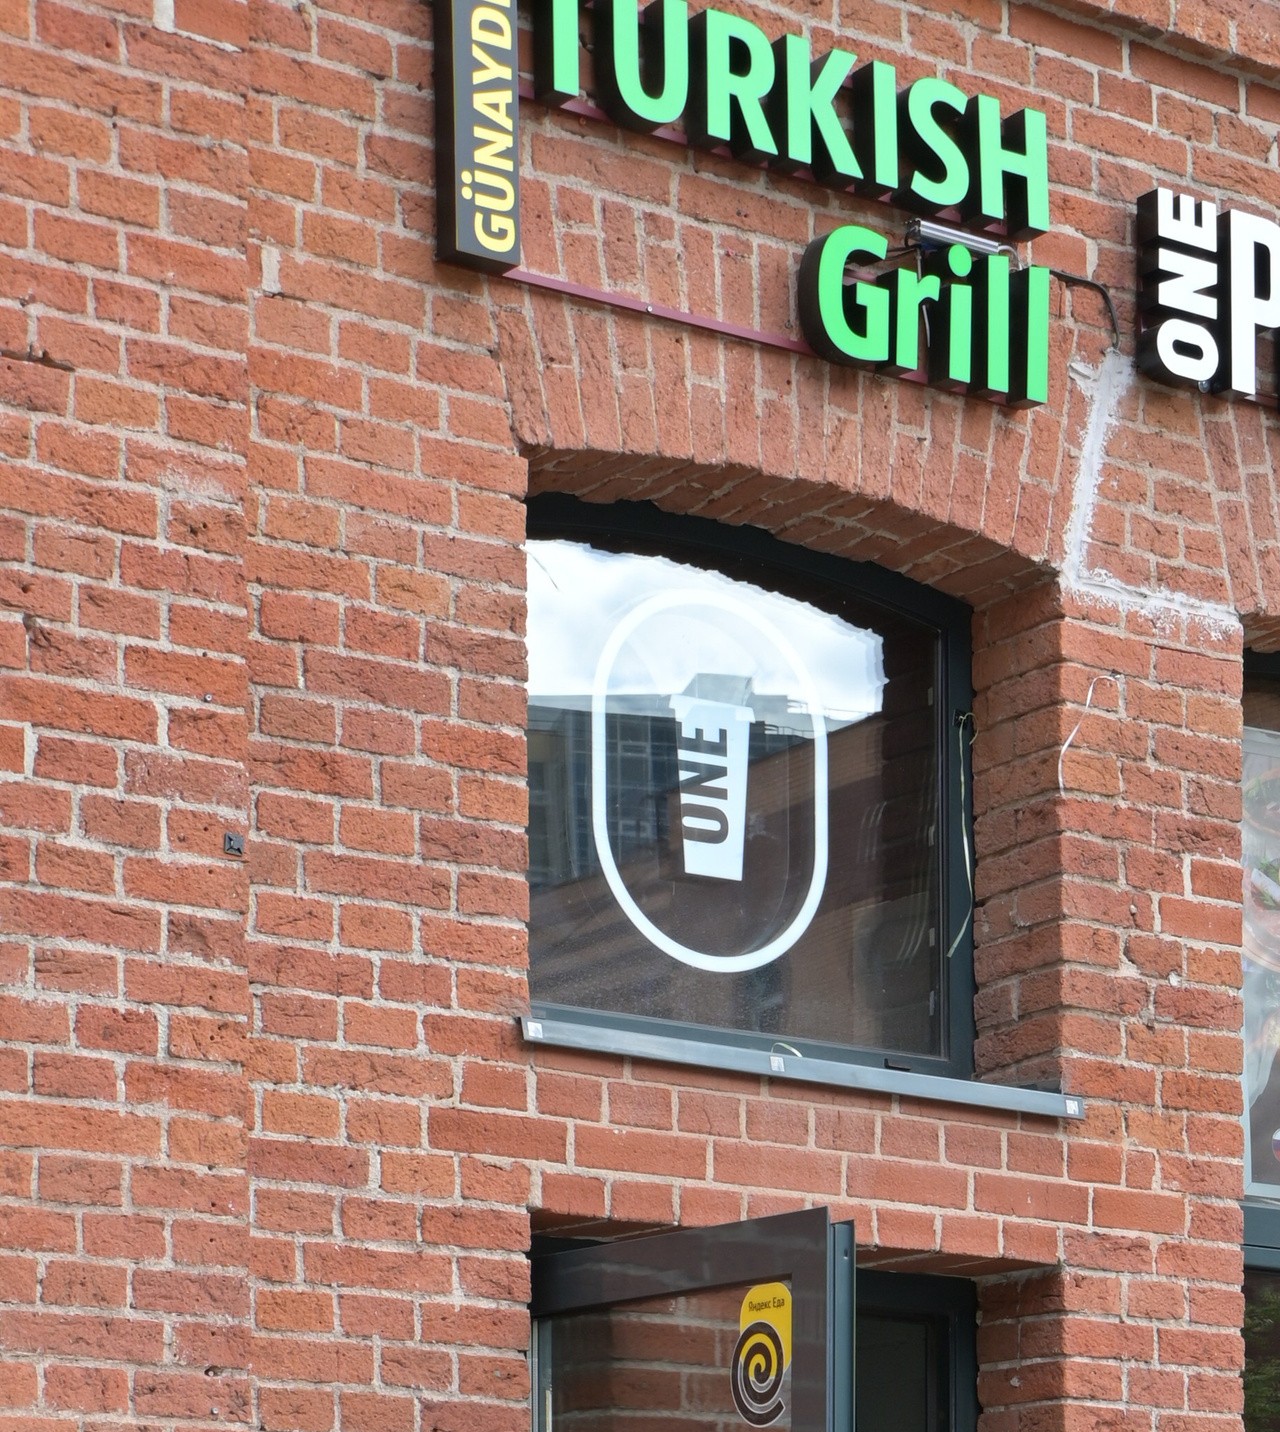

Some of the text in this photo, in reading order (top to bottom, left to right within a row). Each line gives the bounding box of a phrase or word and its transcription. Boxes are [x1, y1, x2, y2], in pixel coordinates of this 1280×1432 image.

[461, 0, 516, 253] GÜNAYD
[818, 225, 1048, 403] Grill
[1157, 187, 1219, 382] ONE
[676, 721, 729, 845] ONE
[748, 1300, 772, 1312] Яндекс
